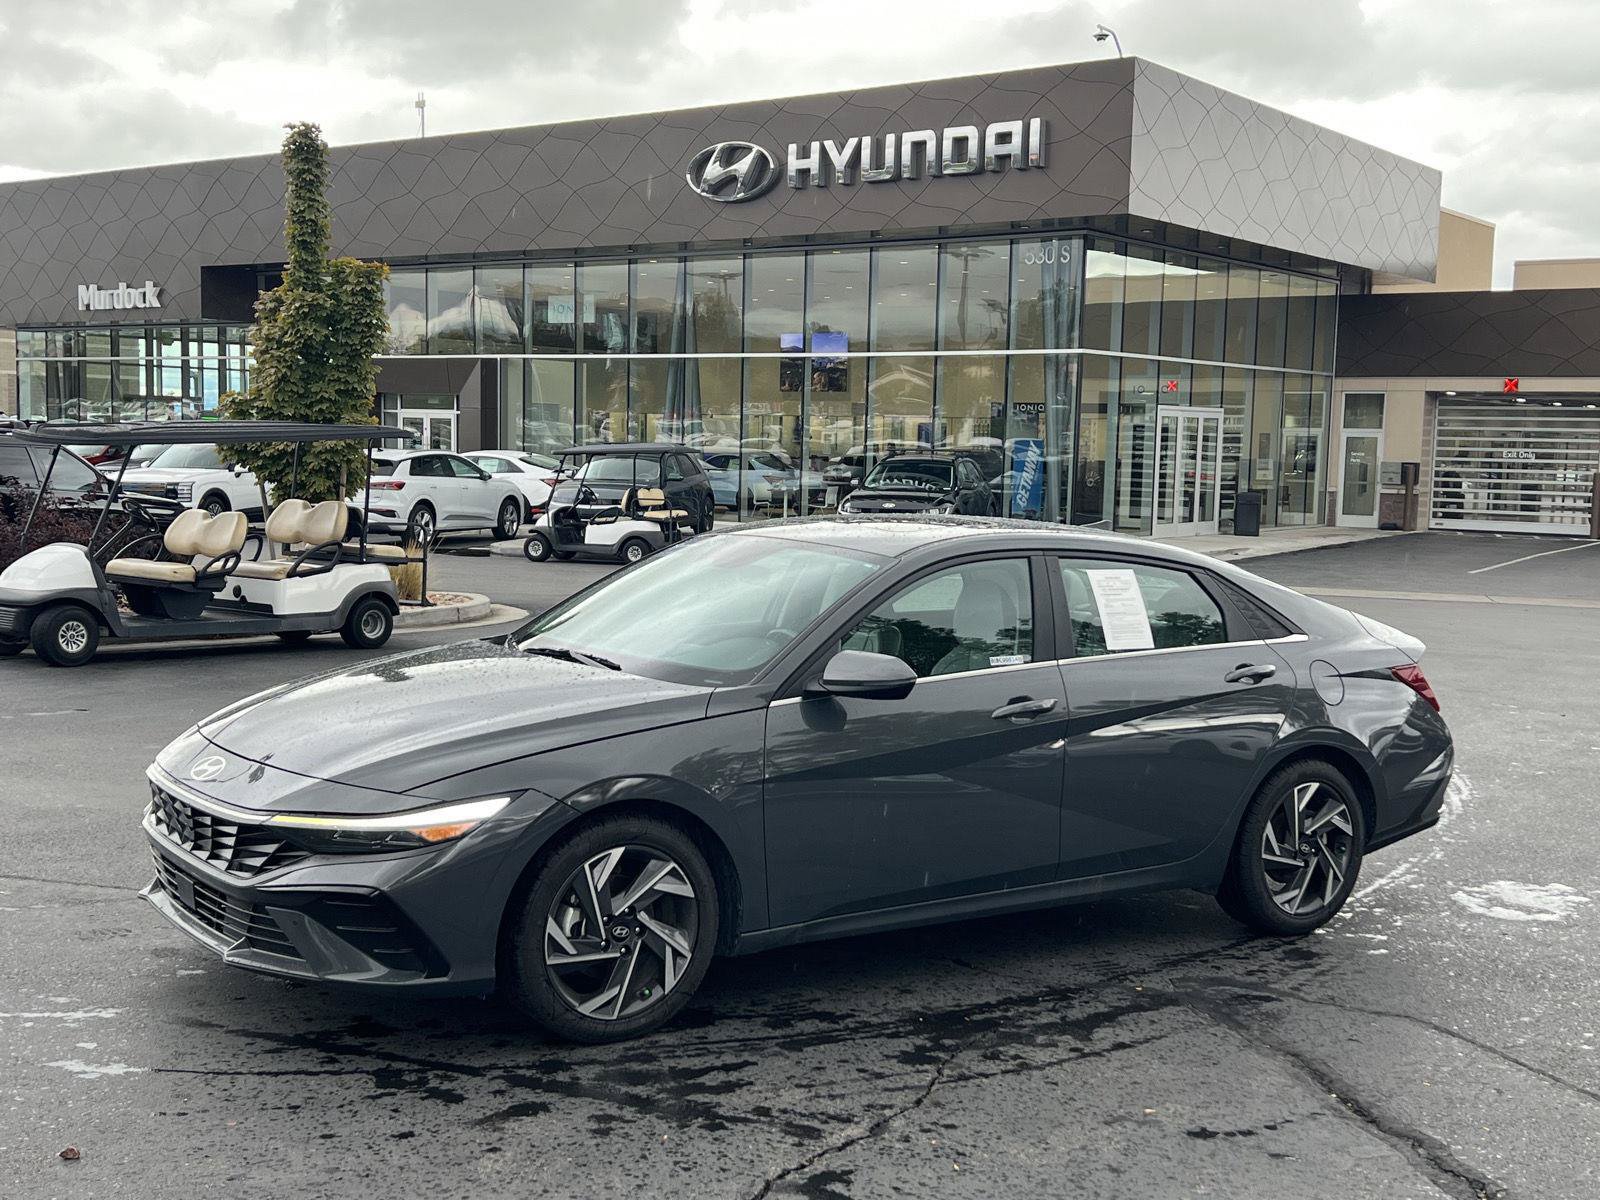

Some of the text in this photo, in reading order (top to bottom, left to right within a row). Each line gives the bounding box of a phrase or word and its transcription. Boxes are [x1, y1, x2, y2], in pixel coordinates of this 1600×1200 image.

[787, 117, 1046, 189] HYUNDAI
[1060, 245, 1070, 263] S
[78, 280, 161, 311] Murdock
[1502, 450, 1536, 461] Exit Only
